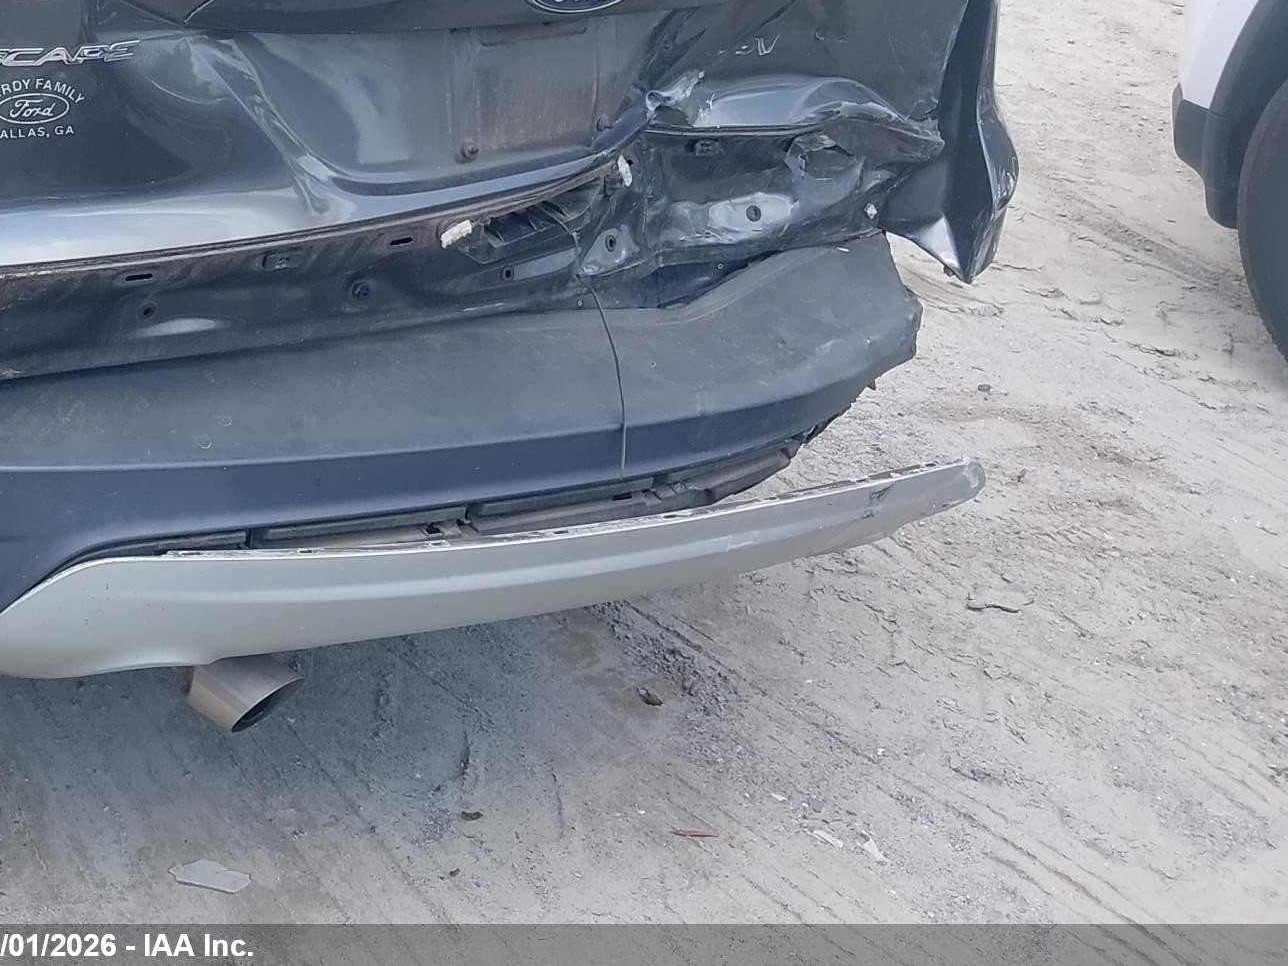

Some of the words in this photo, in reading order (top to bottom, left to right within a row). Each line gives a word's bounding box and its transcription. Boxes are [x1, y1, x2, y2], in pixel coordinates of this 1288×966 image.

[35, 78, 85, 104] FAMILY
[9, 98, 56, 118] Ford
[54, 125, 75, 135] GA
